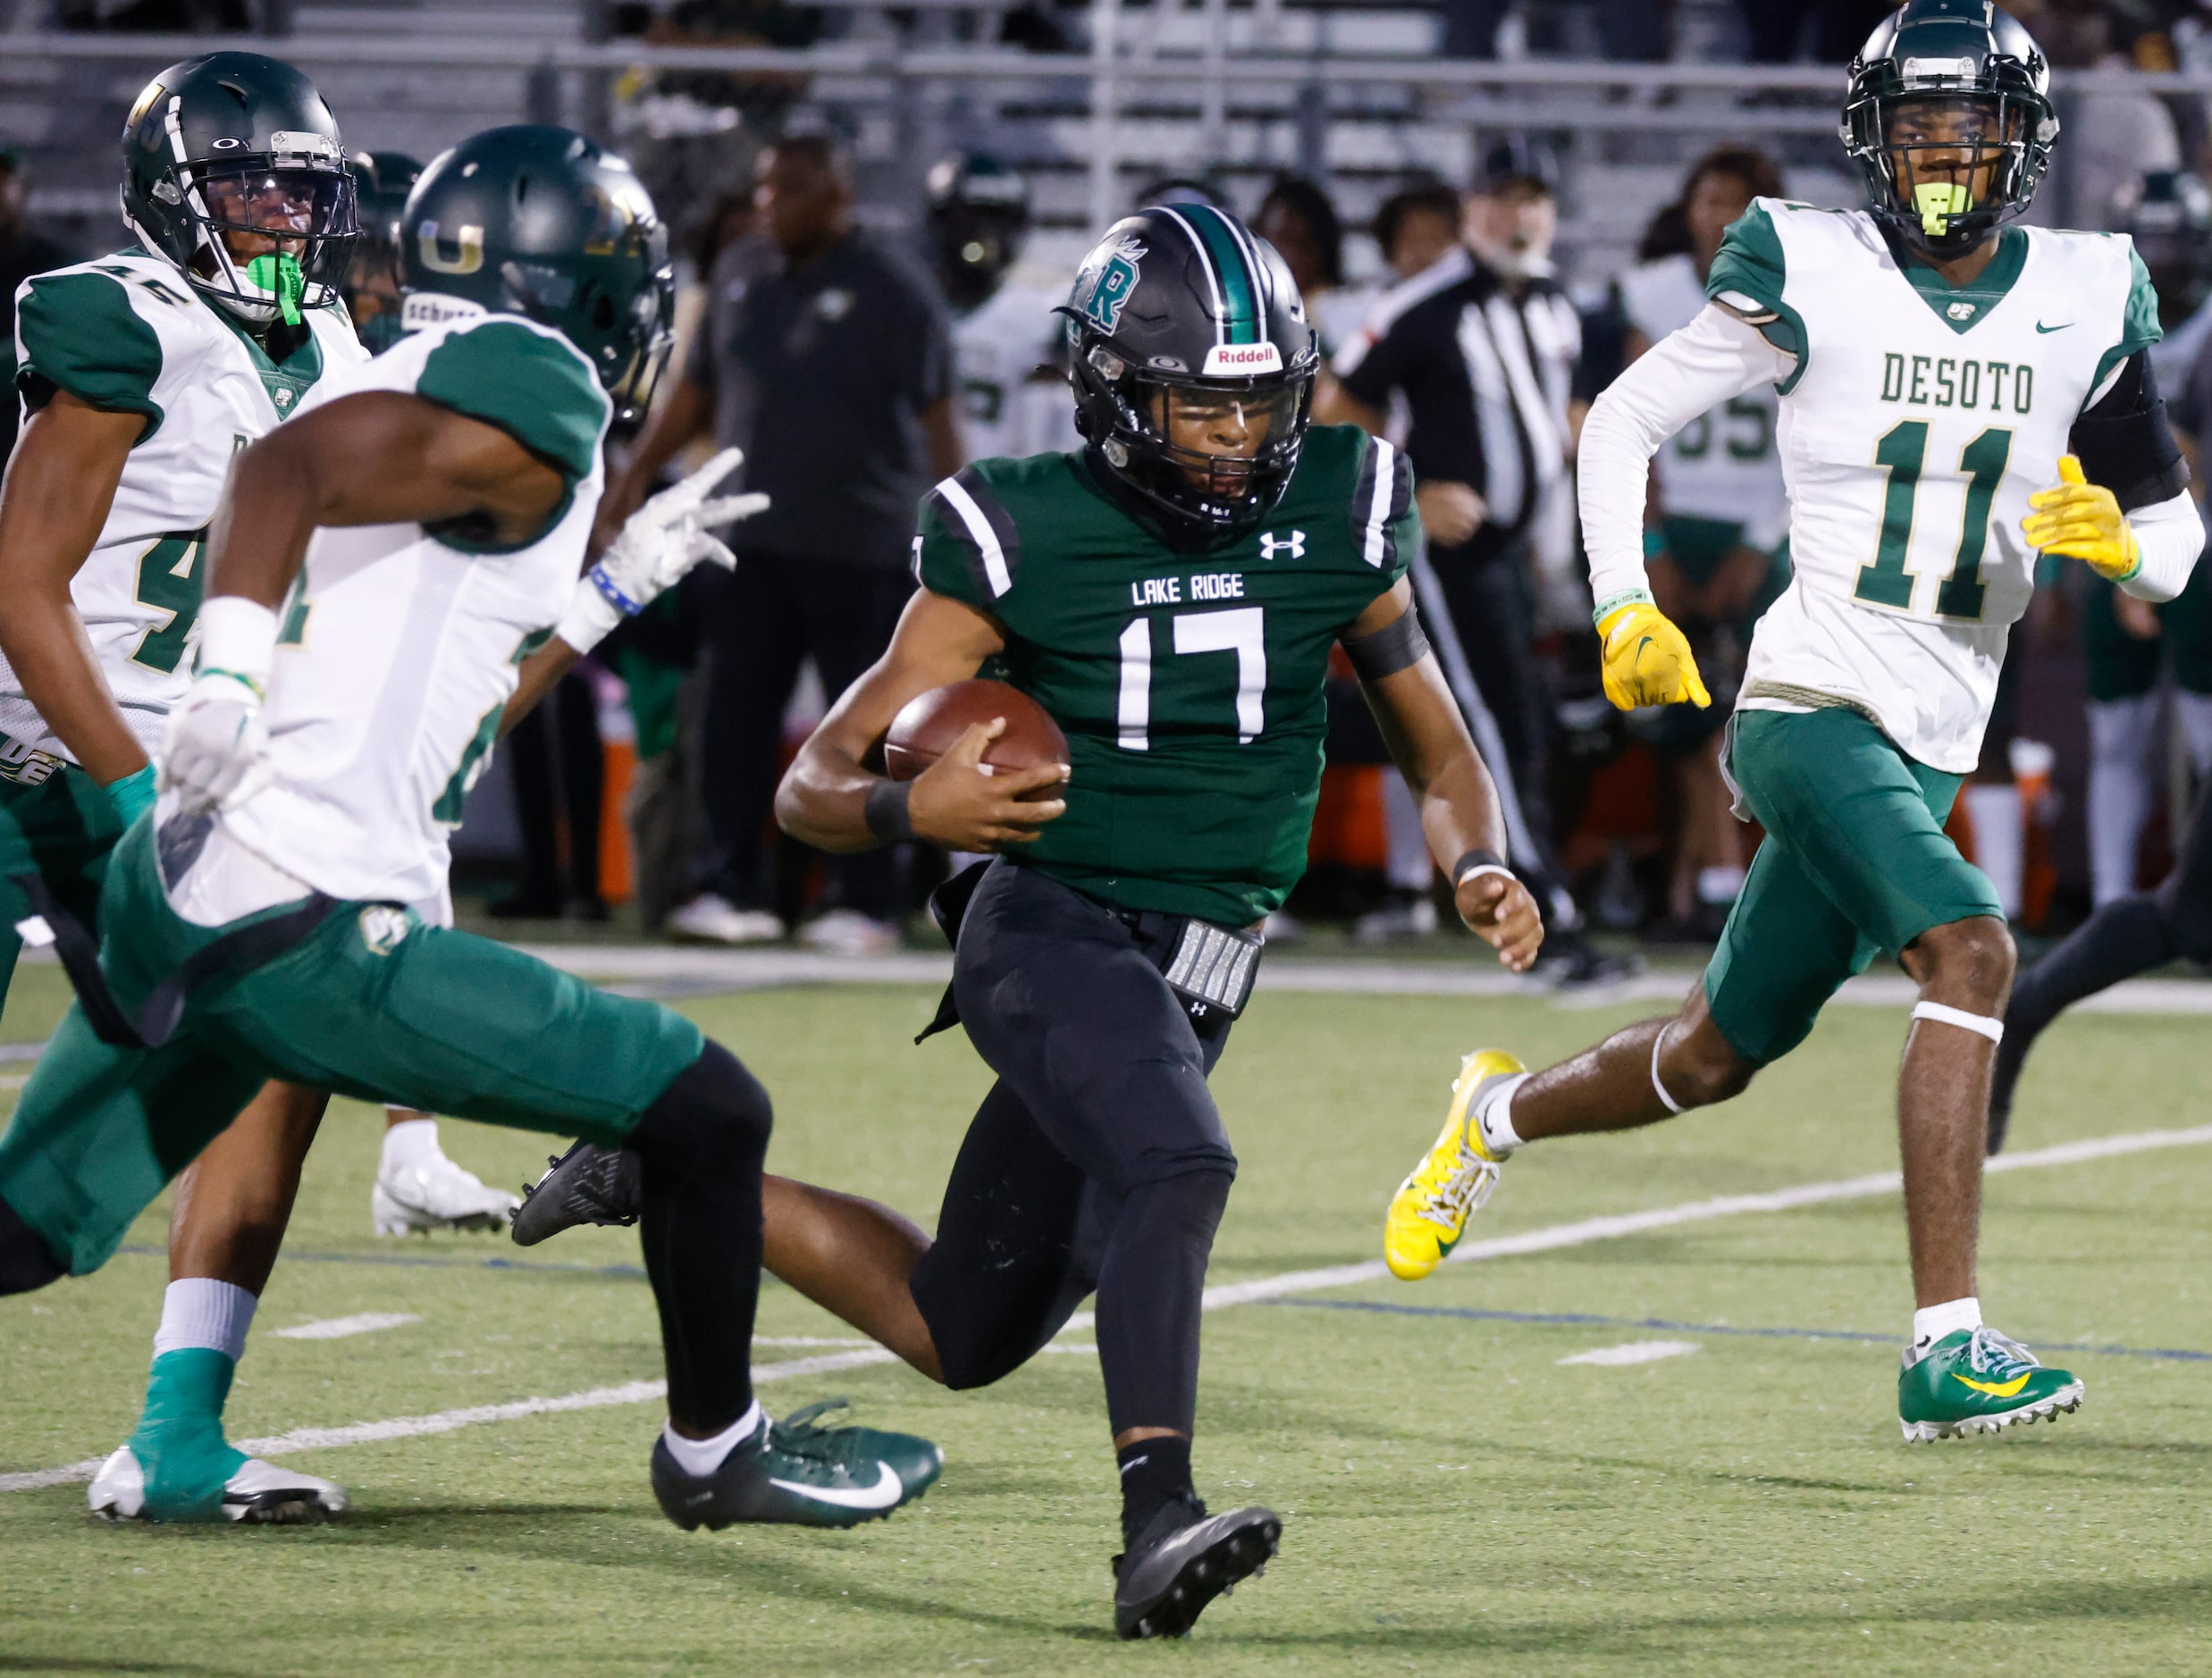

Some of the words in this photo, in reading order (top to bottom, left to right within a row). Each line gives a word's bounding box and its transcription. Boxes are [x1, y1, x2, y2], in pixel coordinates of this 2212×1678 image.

[409, 302, 477, 323] schu
[1218, 348, 1274, 364] Riddell
[1880, 351, 2034, 415] DESOTO
[1848, 415, 2017, 623] 11
[123, 514, 214, 684] 4
[1131, 577, 1182, 606] LAKE
[1190, 574, 1245, 600] RIDGE
[1118, 607, 1267, 751] 17
